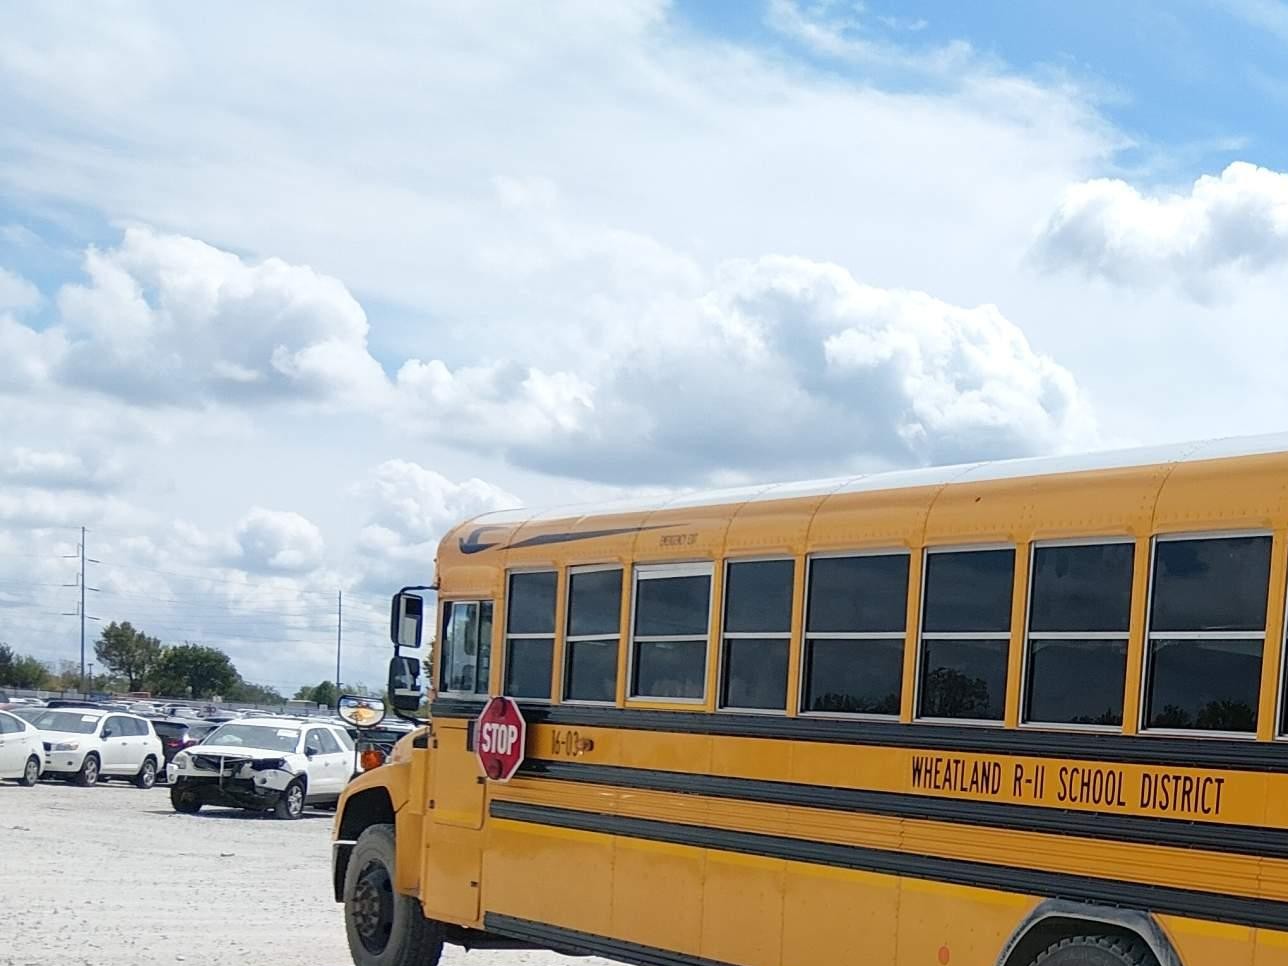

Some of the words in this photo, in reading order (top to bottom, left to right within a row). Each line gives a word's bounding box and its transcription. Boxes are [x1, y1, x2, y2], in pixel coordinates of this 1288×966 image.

[482, 722, 518, 755] STOP
[912, 756, 1000, 795] WHEATLAND
[1057, 766, 1126, 807] SCHOOL
[1140, 773, 1225, 815] DISTRICT
